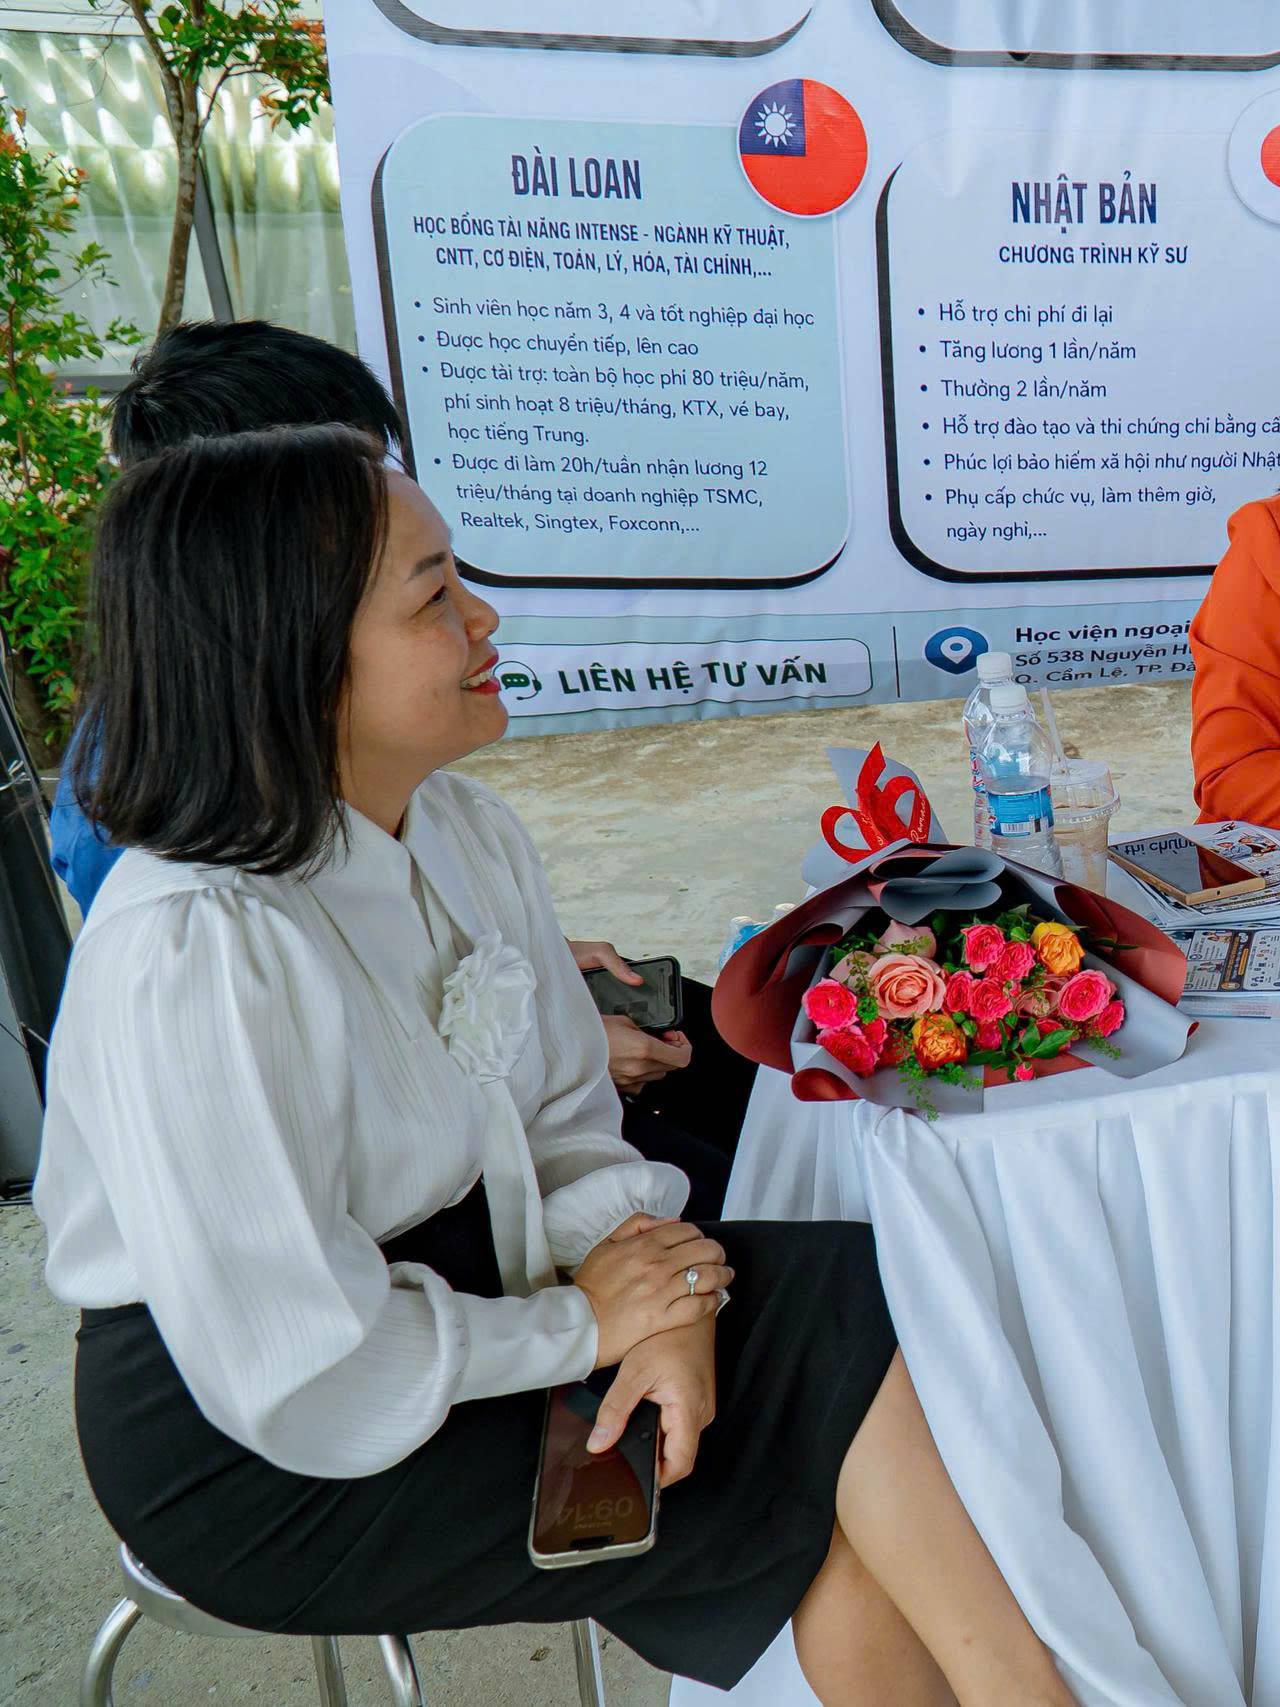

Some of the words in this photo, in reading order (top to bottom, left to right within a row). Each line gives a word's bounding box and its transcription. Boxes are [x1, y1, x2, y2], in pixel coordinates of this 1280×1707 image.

[511, 145, 558, 197] ĐÀI
[568, 157, 641, 200] LOAN
[1011, 173, 1087, 235] NHẬT
[413, 215, 446, 239] HỌC
[497, 216, 521, 238] TÀI
[526, 217, 570, 240] NĂNG
[575, 222, 639, 242] INTENSE
[653, 221, 708, 245] NGÀNH
[735, 224, 789, 251] THUẬT,
[998, 244, 1074, 264] CHƯƠNG
[1079, 242, 1131, 264] TRÌNH
[1164, 245, 1187, 264] SƯ
[433, 296, 471, 315] Sinh
[475, 298, 511, 317] viên
[516, 299, 549, 322] học
[554, 301, 591, 319] năm
[597, 302, 612, 324] 3,
[619, 303, 630, 320] 4
[635, 303, 655, 322] và
[660, 303, 685, 323] tốt
[688, 306, 747, 327] nghiệp
[753, 307, 777, 328] đại
[783, 307, 814, 329] học
[436, 330, 483, 352] Được
[488, 331, 520, 353] học
[636, 336, 662, 354] lên
[667, 342, 698, 356] cao
[939, 339, 985, 363] Tăng
[991, 340, 1042, 364] lương
[1048, 341, 1055, 359] 1
[1016, 379, 1027, 398] 2
[447, 421, 480, 444] học
[532, 425, 588, 447] Trung.
[944, 452, 987, 470] Phúc
[992, 453, 1011, 474] lợi
[1124, 452, 1149, 473] hội
[1154, 452, 1187, 469] như
[1191, 450, 1237, 473] người
[556, 486, 577, 505] tại
[583, 486, 636, 503] doanh
[640, 487, 698, 508] nghiệp
[703, 488, 762, 508] TSMC,
[460, 511, 529, 532] Realtek,
[534, 513, 603, 534] Singtex,
[946, 521, 986, 542] ngày
[1015, 627, 1061, 645] Học
[1068, 624, 1117, 642] viện
[1124, 620, 1191, 639] ngoại
[1015, 651, 1042, 667] Số
[1047, 650, 1084, 664] 538
[1090, 644, 1167, 663] Nguyễn
[557, 661, 636, 695] LIÊN
[646, 661, 694, 695] HỆ
[701, 659, 747, 688] TƯ
[756, 655, 828, 685] VẤN
[1014, 674, 1038, 685] Q.
[1135, 664, 1162, 675] TP.
